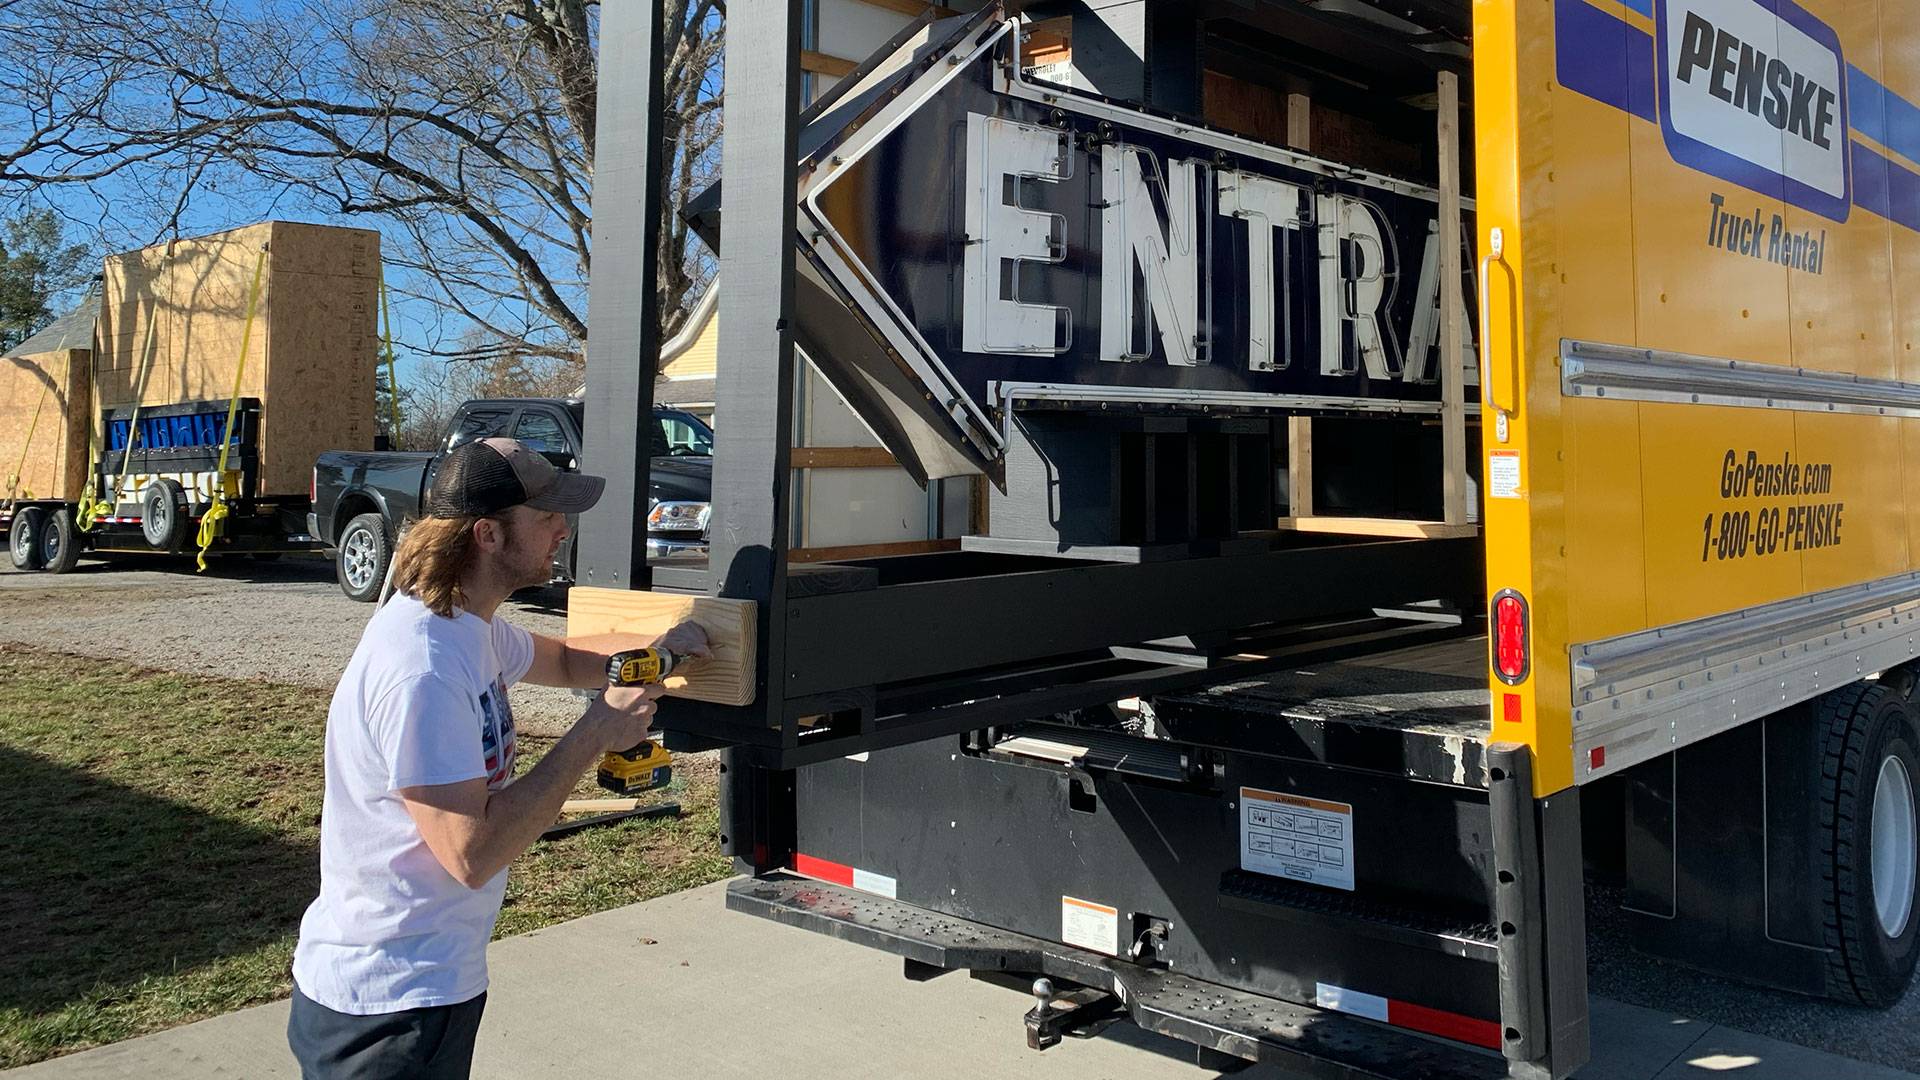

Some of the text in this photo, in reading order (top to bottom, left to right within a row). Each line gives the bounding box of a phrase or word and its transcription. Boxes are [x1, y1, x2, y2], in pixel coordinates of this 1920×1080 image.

[1677, 10, 1835, 150] PENSKE
[1708, 192, 1826, 275] Truck Rental
[1721, 449, 1832, 498] GoPenske.com
[1702, 503, 1844, 562] 1-800-GO-PENSKE
